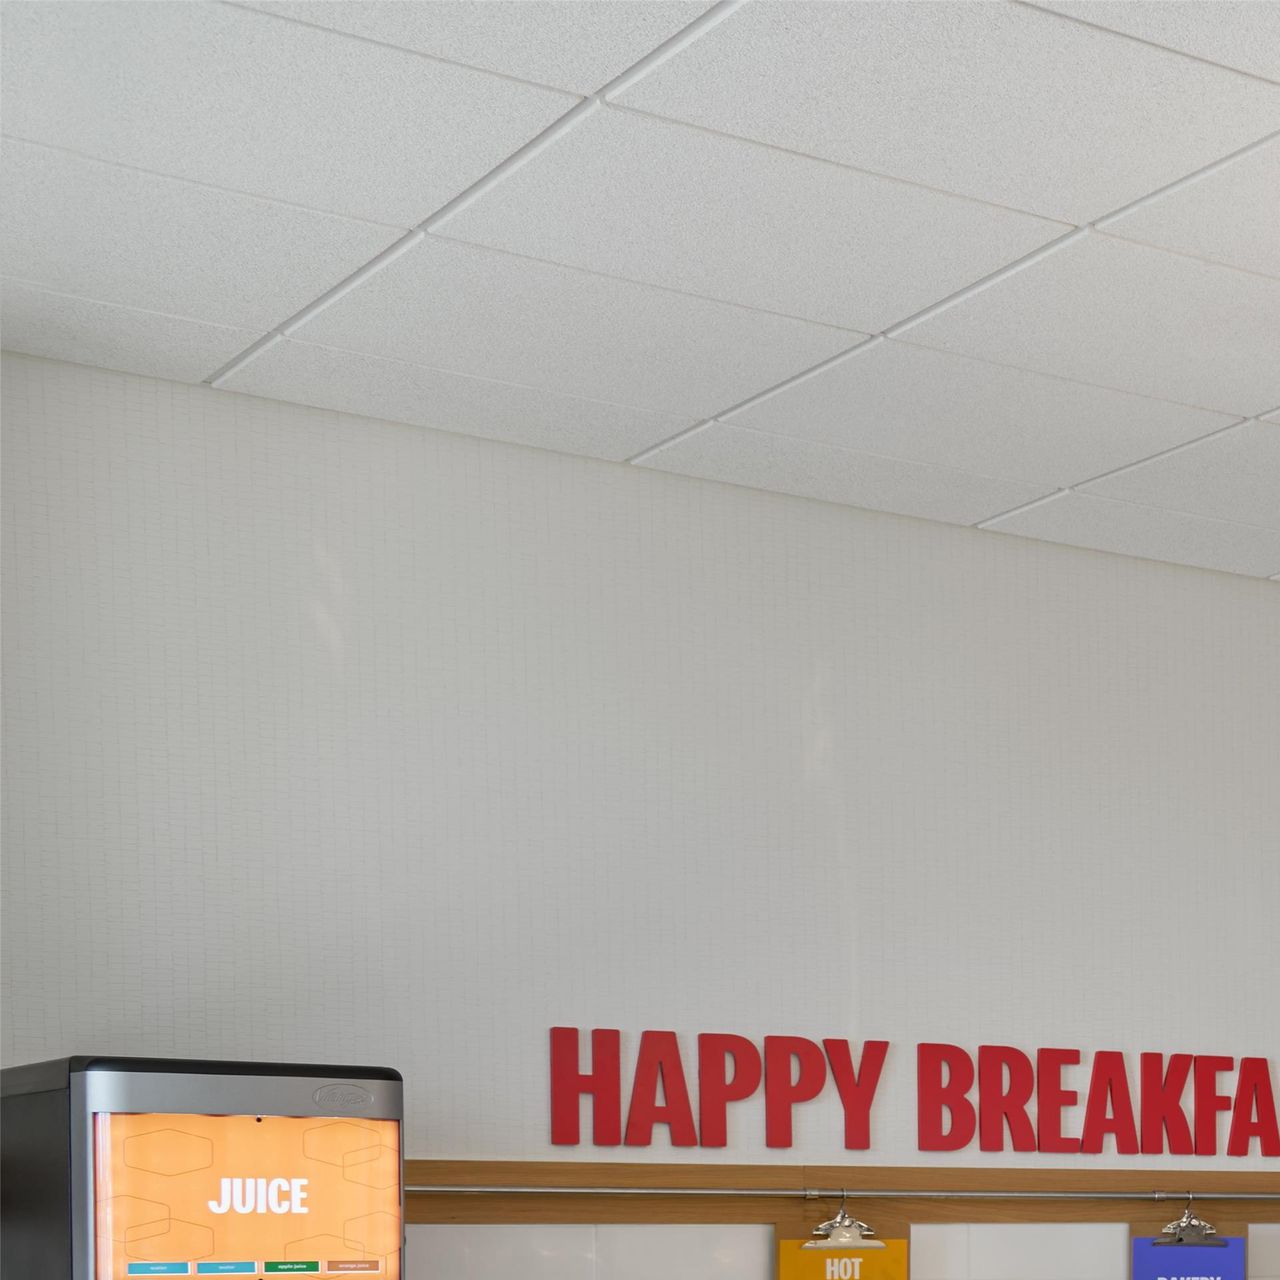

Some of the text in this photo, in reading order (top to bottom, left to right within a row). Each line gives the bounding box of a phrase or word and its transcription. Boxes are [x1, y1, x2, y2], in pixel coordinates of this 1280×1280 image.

[549, 1026, 890, 1150] HAPPY
[208, 1176, 310, 1215] JUICE
[825, 1257, 863, 1280] HOT
